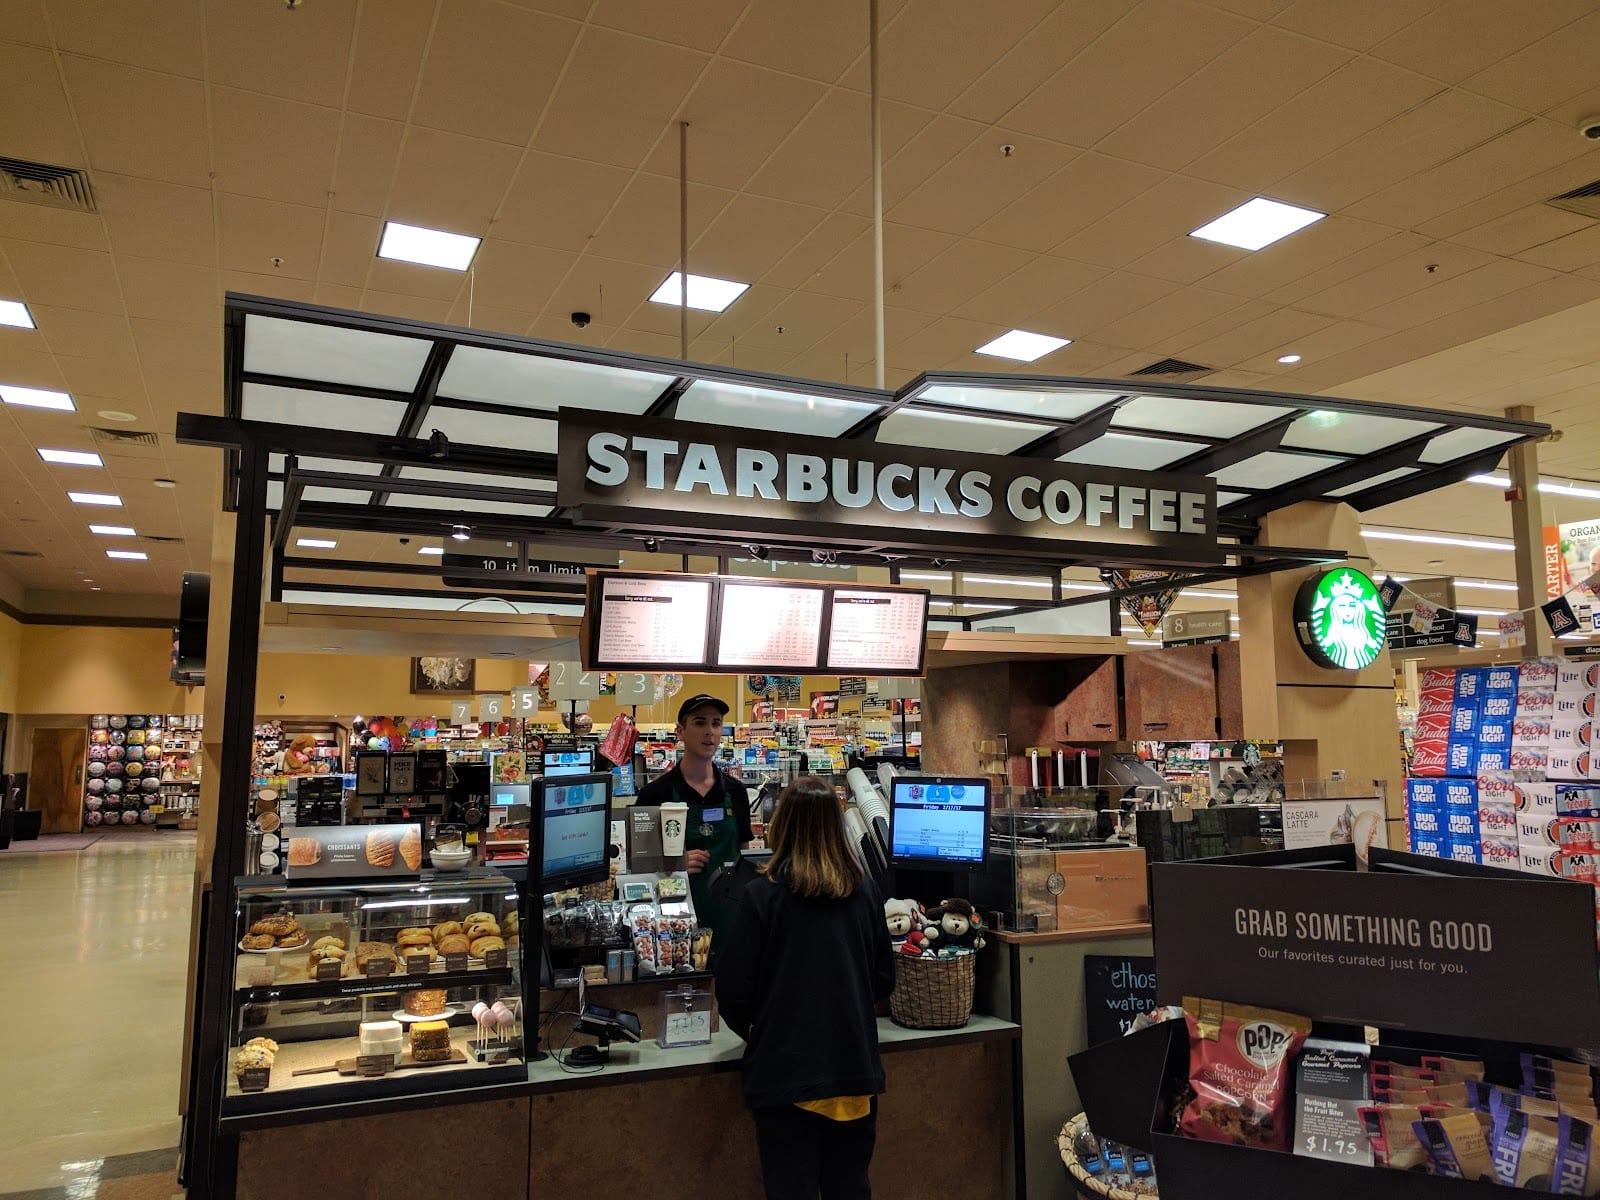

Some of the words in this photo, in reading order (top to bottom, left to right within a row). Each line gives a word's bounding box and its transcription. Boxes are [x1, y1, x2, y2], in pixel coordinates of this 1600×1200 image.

[585, 432, 994, 518] STARBUCKS
[1006, 475, 1207, 535] COFFEE
[483, 559, 497, 571] 10
[506, 560, 540, 573] itm
[1175, 618, 1184, 632] 8
[1416, 637, 1428, 645] dog
[556, 663, 565, 686] 2
[1519, 663, 1558, 677] Coors
[1490, 672, 1511, 681] BUD
[1562, 672, 1579, 683] Lite
[633, 674, 646, 692] 3
[1460, 673, 1470, 698] LIGHT
[1469, 674, 1477, 695] BUD
[1486, 680, 1513, 689] LIGHT
[522, 694, 533, 709] 5
[1487, 699, 1509, 707] BUD
[1517, 689, 1554, 706] Coors
[488, 701, 498, 714] 6
[1484, 706, 1511, 716] LIGHT
[1524, 704, 1544, 712] LIGHT
[1558, 701, 1575, 711] Lite
[458, 706, 466, 718] 7
[1456, 707, 1465, 733] LIGHT
[1464, 709, 1473, 731] BUD
[1482, 726, 1503, 734] BUD
[1513, 720, 1550, 736] Coors
[1479, 734, 1505, 743] LIGHT
[1554, 729, 1571, 740] Lite
[1451, 743, 1461, 769] LIGHT
[1459, 746, 1468, 768] BUD
[1480, 753, 1502, 761] BUD
[1510, 751, 1548, 767] Coors
[1477, 761, 1504, 770] LIGHT
[1552, 758, 1569, 769] Lite
[1414, 785, 1433, 793] BUD
[1477, 776, 1516, 791] Coors
[1449, 786, 1469, 795] BUD
[1412, 793, 1436, 803] LIGHT
[1447, 794, 1472, 804] LIGHT
[1536, 795, 1553, 805] Lite
[1566, 800, 1592, 809] TECATE
[1286, 811, 1319, 820] CASCARA
[1415, 813, 1435, 822] BUD
[1450, 816, 1471, 824] BUD
[1479, 808, 1517, 824] Coors
[1287, 820, 1308, 829] LATTE
[1414, 821, 1438, 831] LIGHT
[1448, 824, 1474, 834] LIGHT
[1522, 825, 1539, 836] Lite
[1569, 832, 1594, 841] TECATE
[1417, 842, 1437, 850] BUD
[1453, 845, 1473, 853] BUD
[1482, 840, 1520, 857] Coors
[1451, 853, 1477, 863] LIGHT
[1489, 856, 1510, 864] LIGHT
[1525, 855, 1542, 867] Lite
[1572, 864, 1598, 874] TECATE
[1235, 907, 1288, 938] GRAB
[1295, 911, 1421, 947] SOMETHING
[1429, 919, 1492, 952] GOOD
[1258, 946, 1279, 959] Our
[1283, 948, 1335, 964] favorites
[1338, 954, 1385, 967] curated
[1390, 957, 1414, 970] just
[1418, 958, 1436, 971] for
[1440, 961, 1468, 974] you.
[1112, 961, 1156, 989] ethos
[1106, 993, 1154, 1011] water
[1329, 1055, 1358, 1063] Caramel
[1333, 1062, 1361, 1070] Popcorn
[1215, 1063, 1269, 1081] Chocolate
[1204, 1070, 1234, 1082] Salted
[1237, 1077, 1279, 1090] Caramel
[1304, 1098, 1327, 1109] Nothing
[1327, 1101, 1338, 1109] But
[1328, 1109, 1344, 1117] Bites
[1306, 1135, 1357, 1155] $1.95
